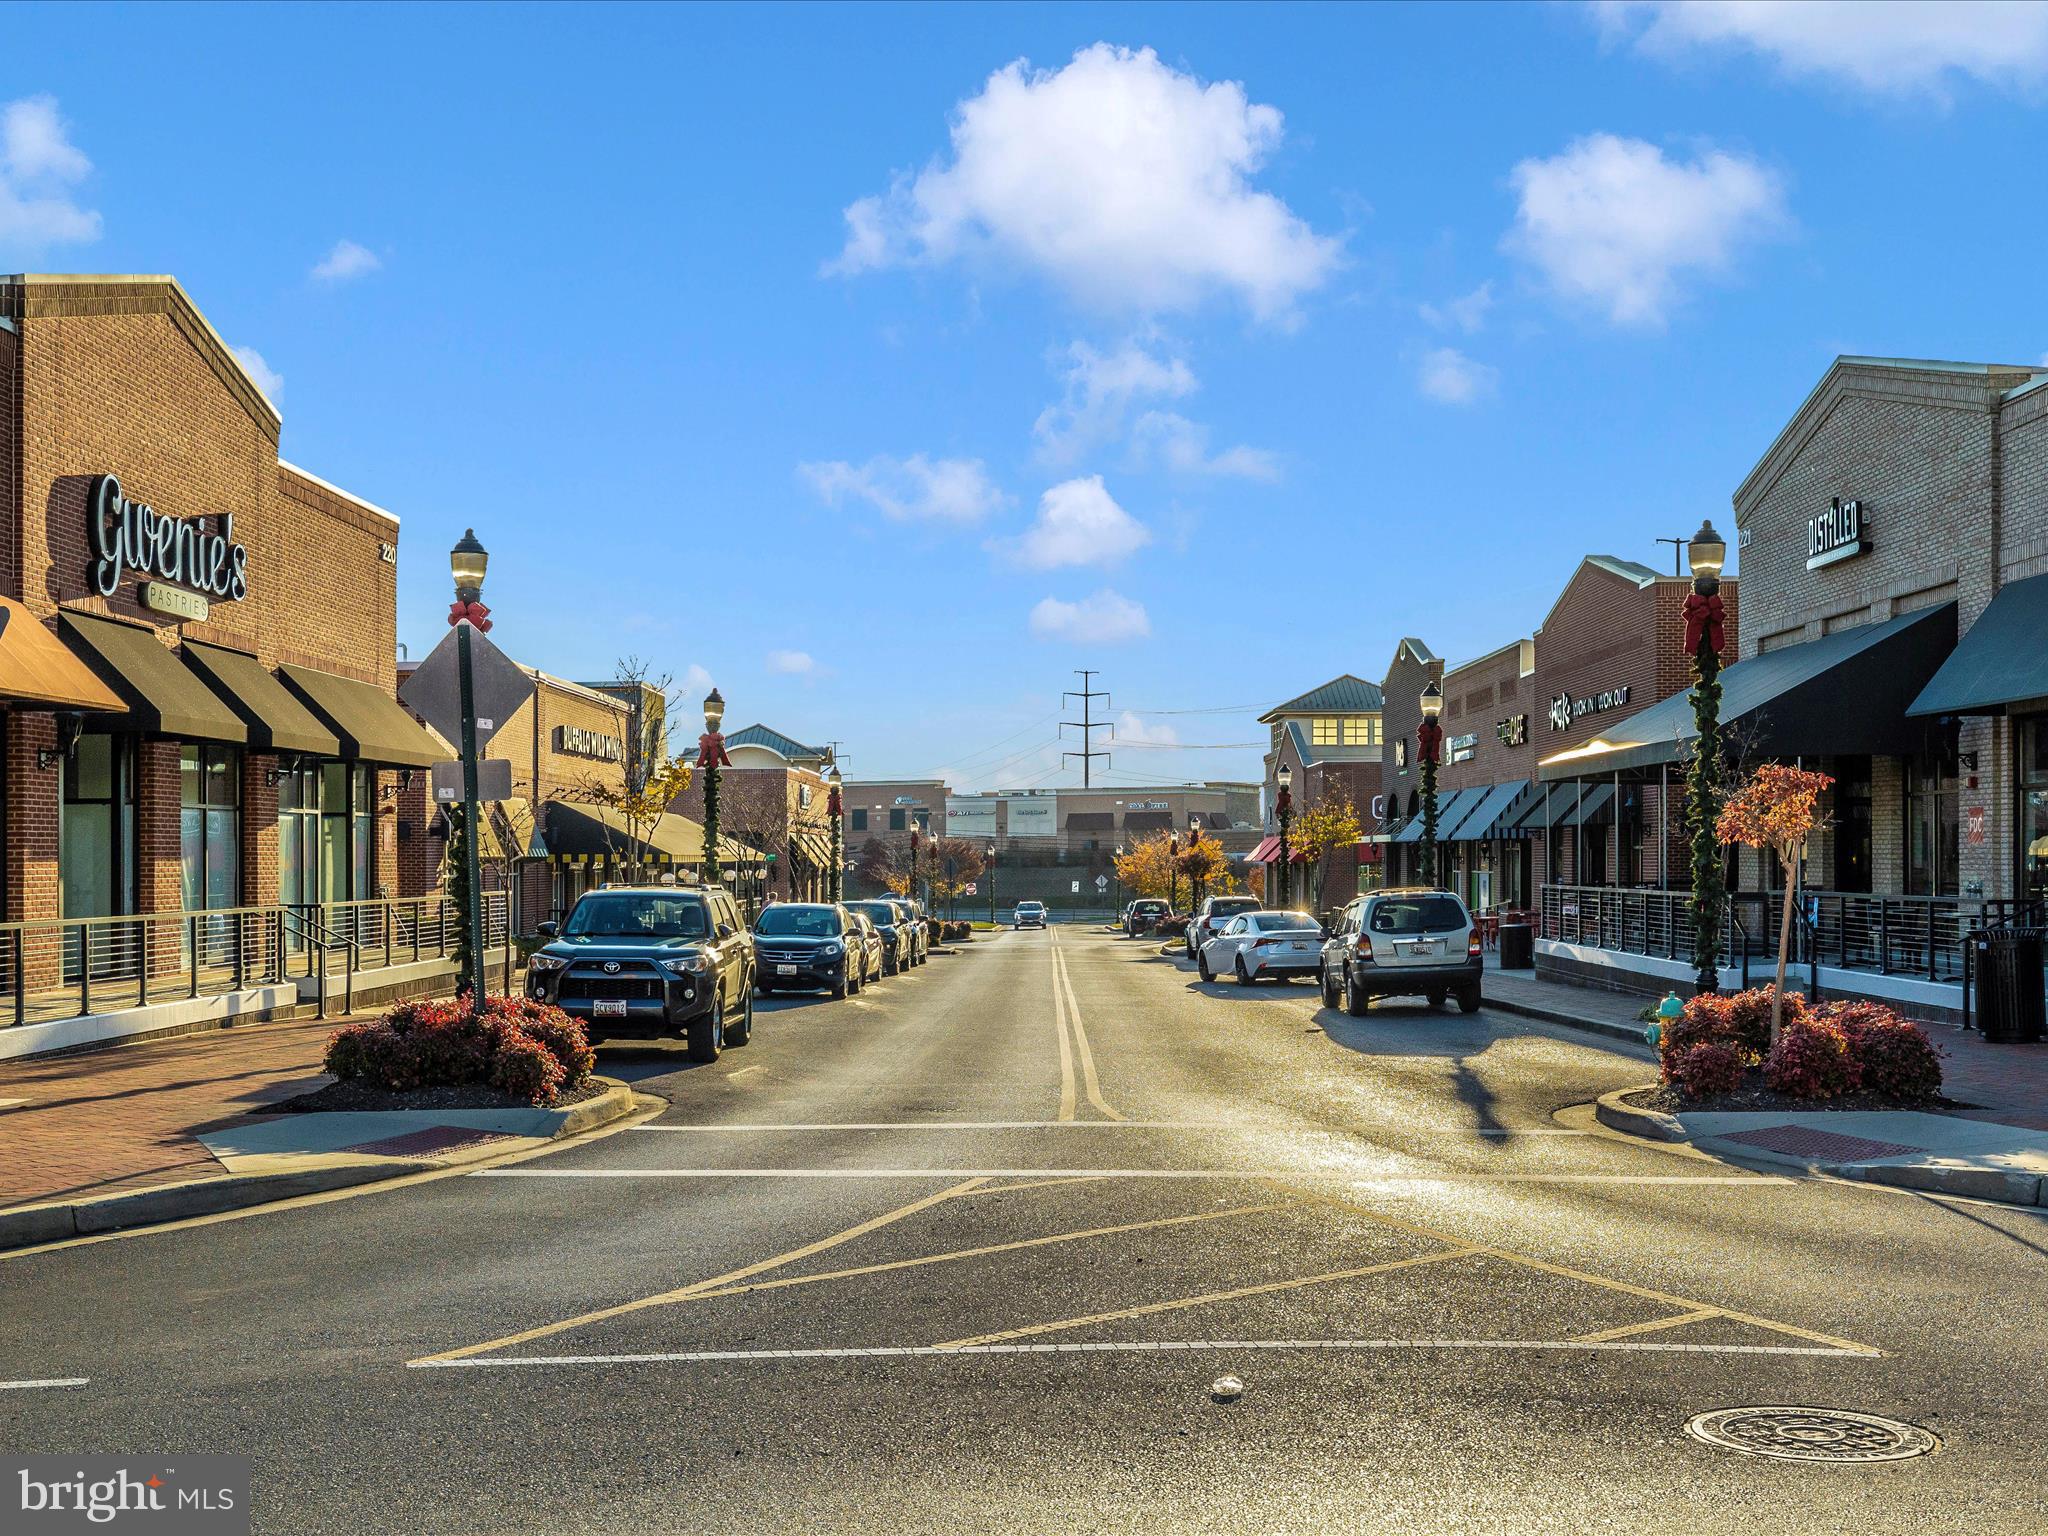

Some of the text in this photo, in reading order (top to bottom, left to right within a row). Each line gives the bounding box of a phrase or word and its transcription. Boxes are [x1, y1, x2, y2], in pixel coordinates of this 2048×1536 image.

[98, 474, 247, 602] Gwenie's
[1740, 529, 1751, 548] 221
[383, 543, 396, 564] 220
[150, 586, 207, 616] PASTRIES
[1573, 699, 1587, 717] WOK
[1588, 696, 1594, 713] IN
[1598, 692, 1613, 710] WOK
[1614, 686, 1628, 706] OUT
[1969, 816, 1983, 833] FDC
